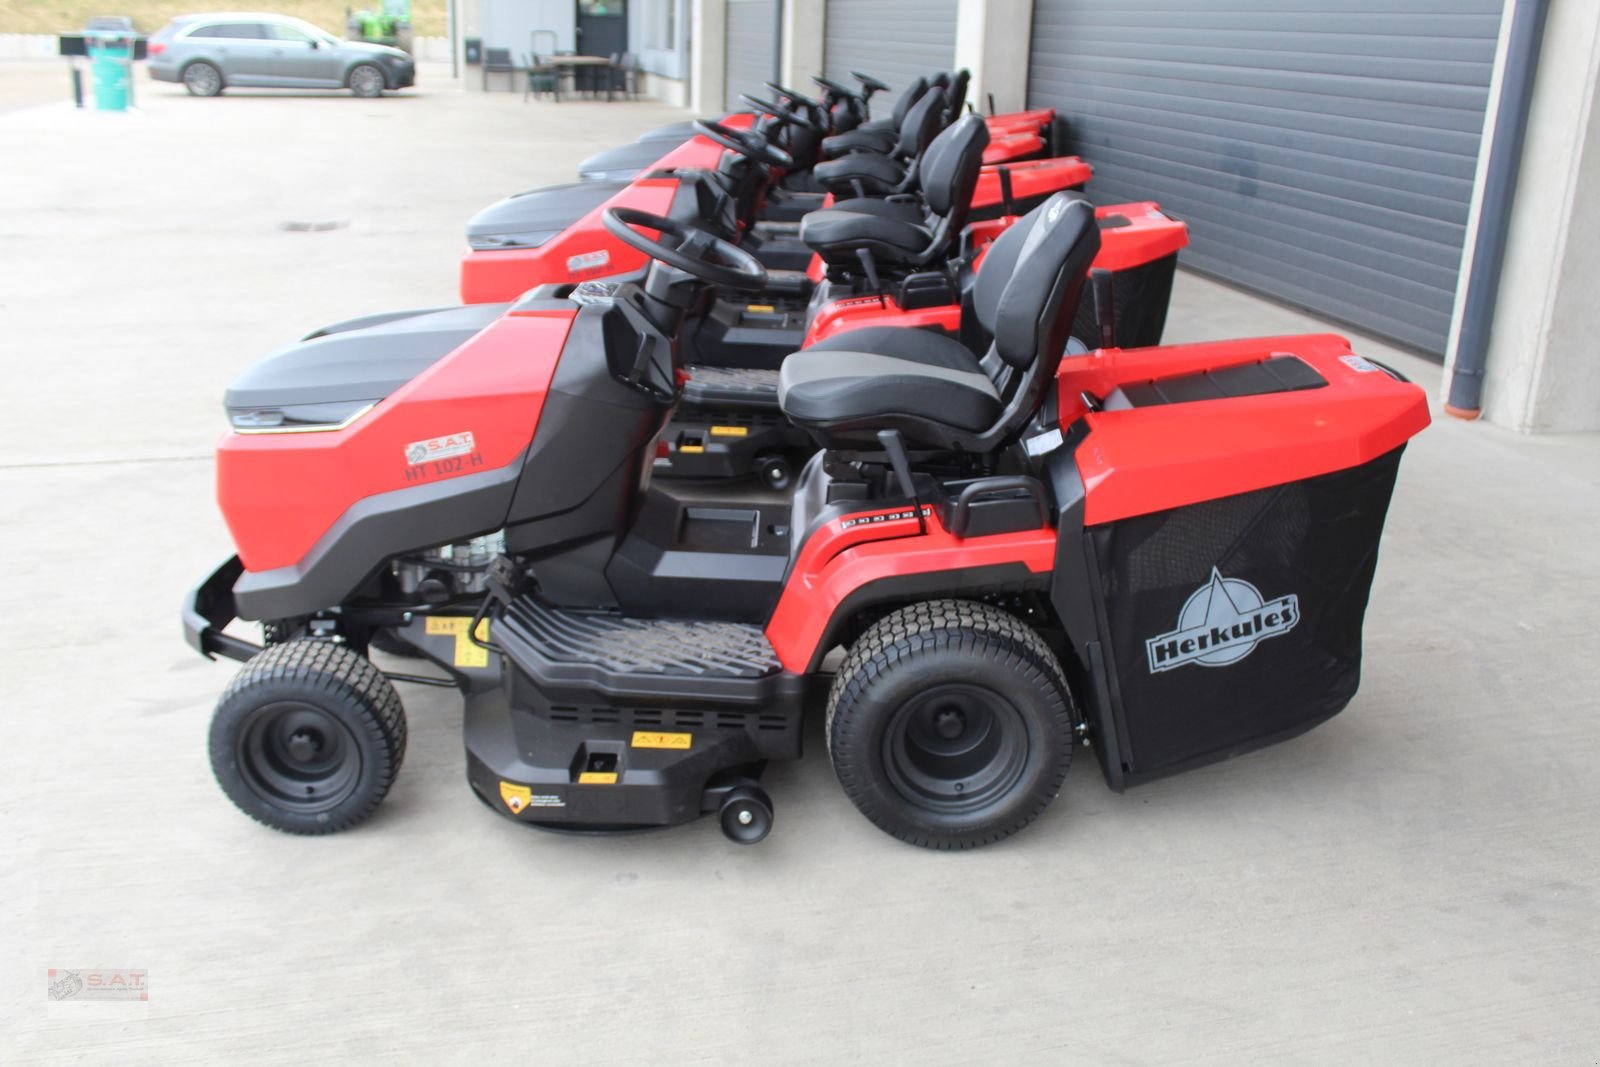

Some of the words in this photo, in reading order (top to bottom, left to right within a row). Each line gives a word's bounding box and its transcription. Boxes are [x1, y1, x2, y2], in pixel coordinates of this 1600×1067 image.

[405, 464, 426, 481] HT
[433, 452, 483, 475] 102-H
[1155, 598, 1292, 663] Herkules
